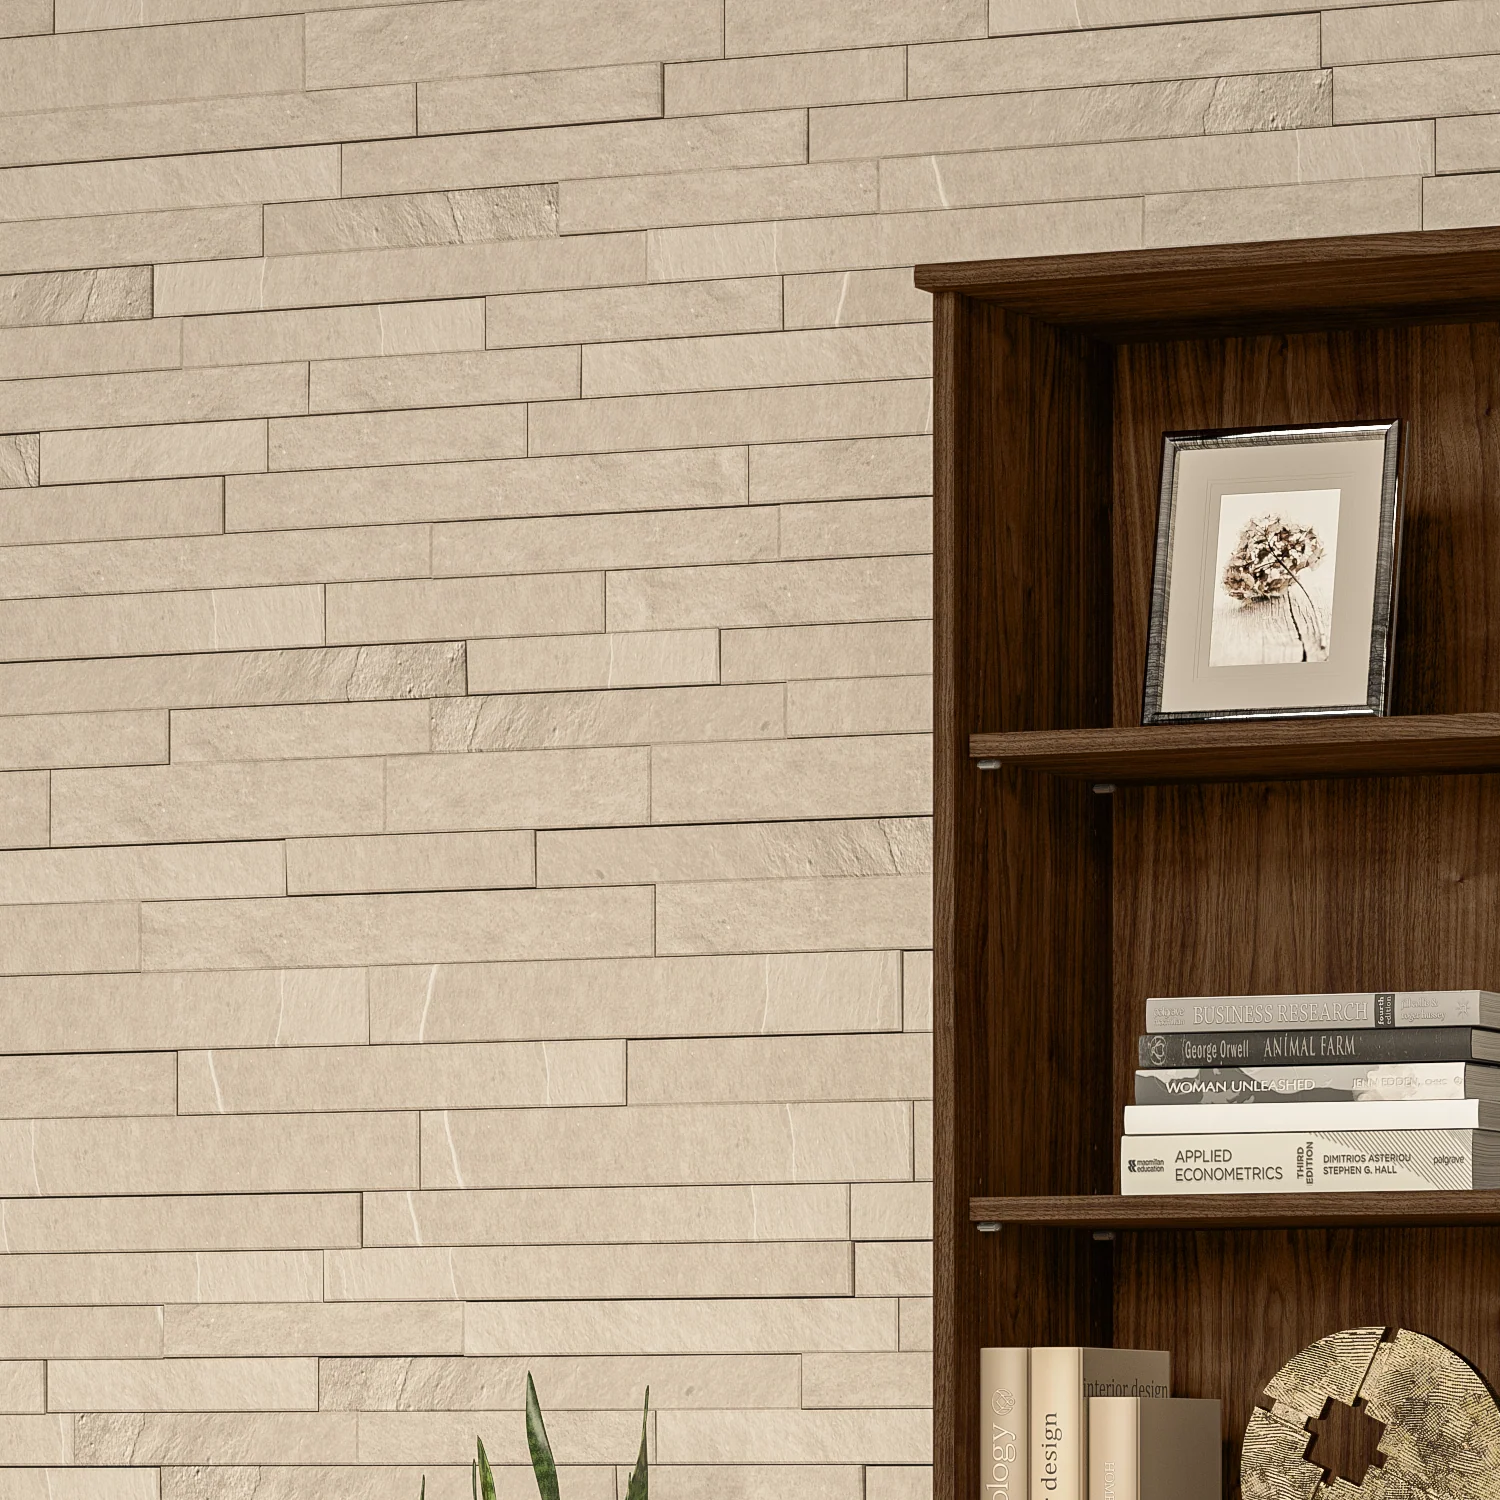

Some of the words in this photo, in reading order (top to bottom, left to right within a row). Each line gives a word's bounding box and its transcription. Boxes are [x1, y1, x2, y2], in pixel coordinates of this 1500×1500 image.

[1193, 1004, 1274, 1025] BUSINESS
[1277, 1001, 1368, 1024] RESEARCH
[1377, 996, 1385, 1026] fourth
[1184, 1040, 1217, 1063] George
[1220, 1039, 1249, 1059] Orwell
[1321, 1035, 1356, 1056] FARM
[1166, 1081, 1227, 1094] WOMAN
[1231, 1079, 1316, 1093] UNLEASHED
[1175, 1149, 1232, 1163] APPLIED
[1296, 1147, 1304, 1179] THIRD
[1306, 1141, 1314, 1184] EDITION
[1323, 1154, 1366, 1164] DIMITRIOS
[1368, 1153, 1411, 1163] ASTERIOU
[1433, 1155, 1465, 1166] palgrave
[1137, 1165, 1165, 1173] education
[1175, 1166, 1283, 1181] ECONOMETRICS
[1323, 1166, 1362, 1175] STEPHEN
[1363, 1166, 1373, 1174] G.
[1375, 1165, 1397, 1174] HALL
[1083, 1377, 1128, 1397] interior
[1131, 1378, 1168, 1398] design
[1040, 1412, 1063, 1490] design
